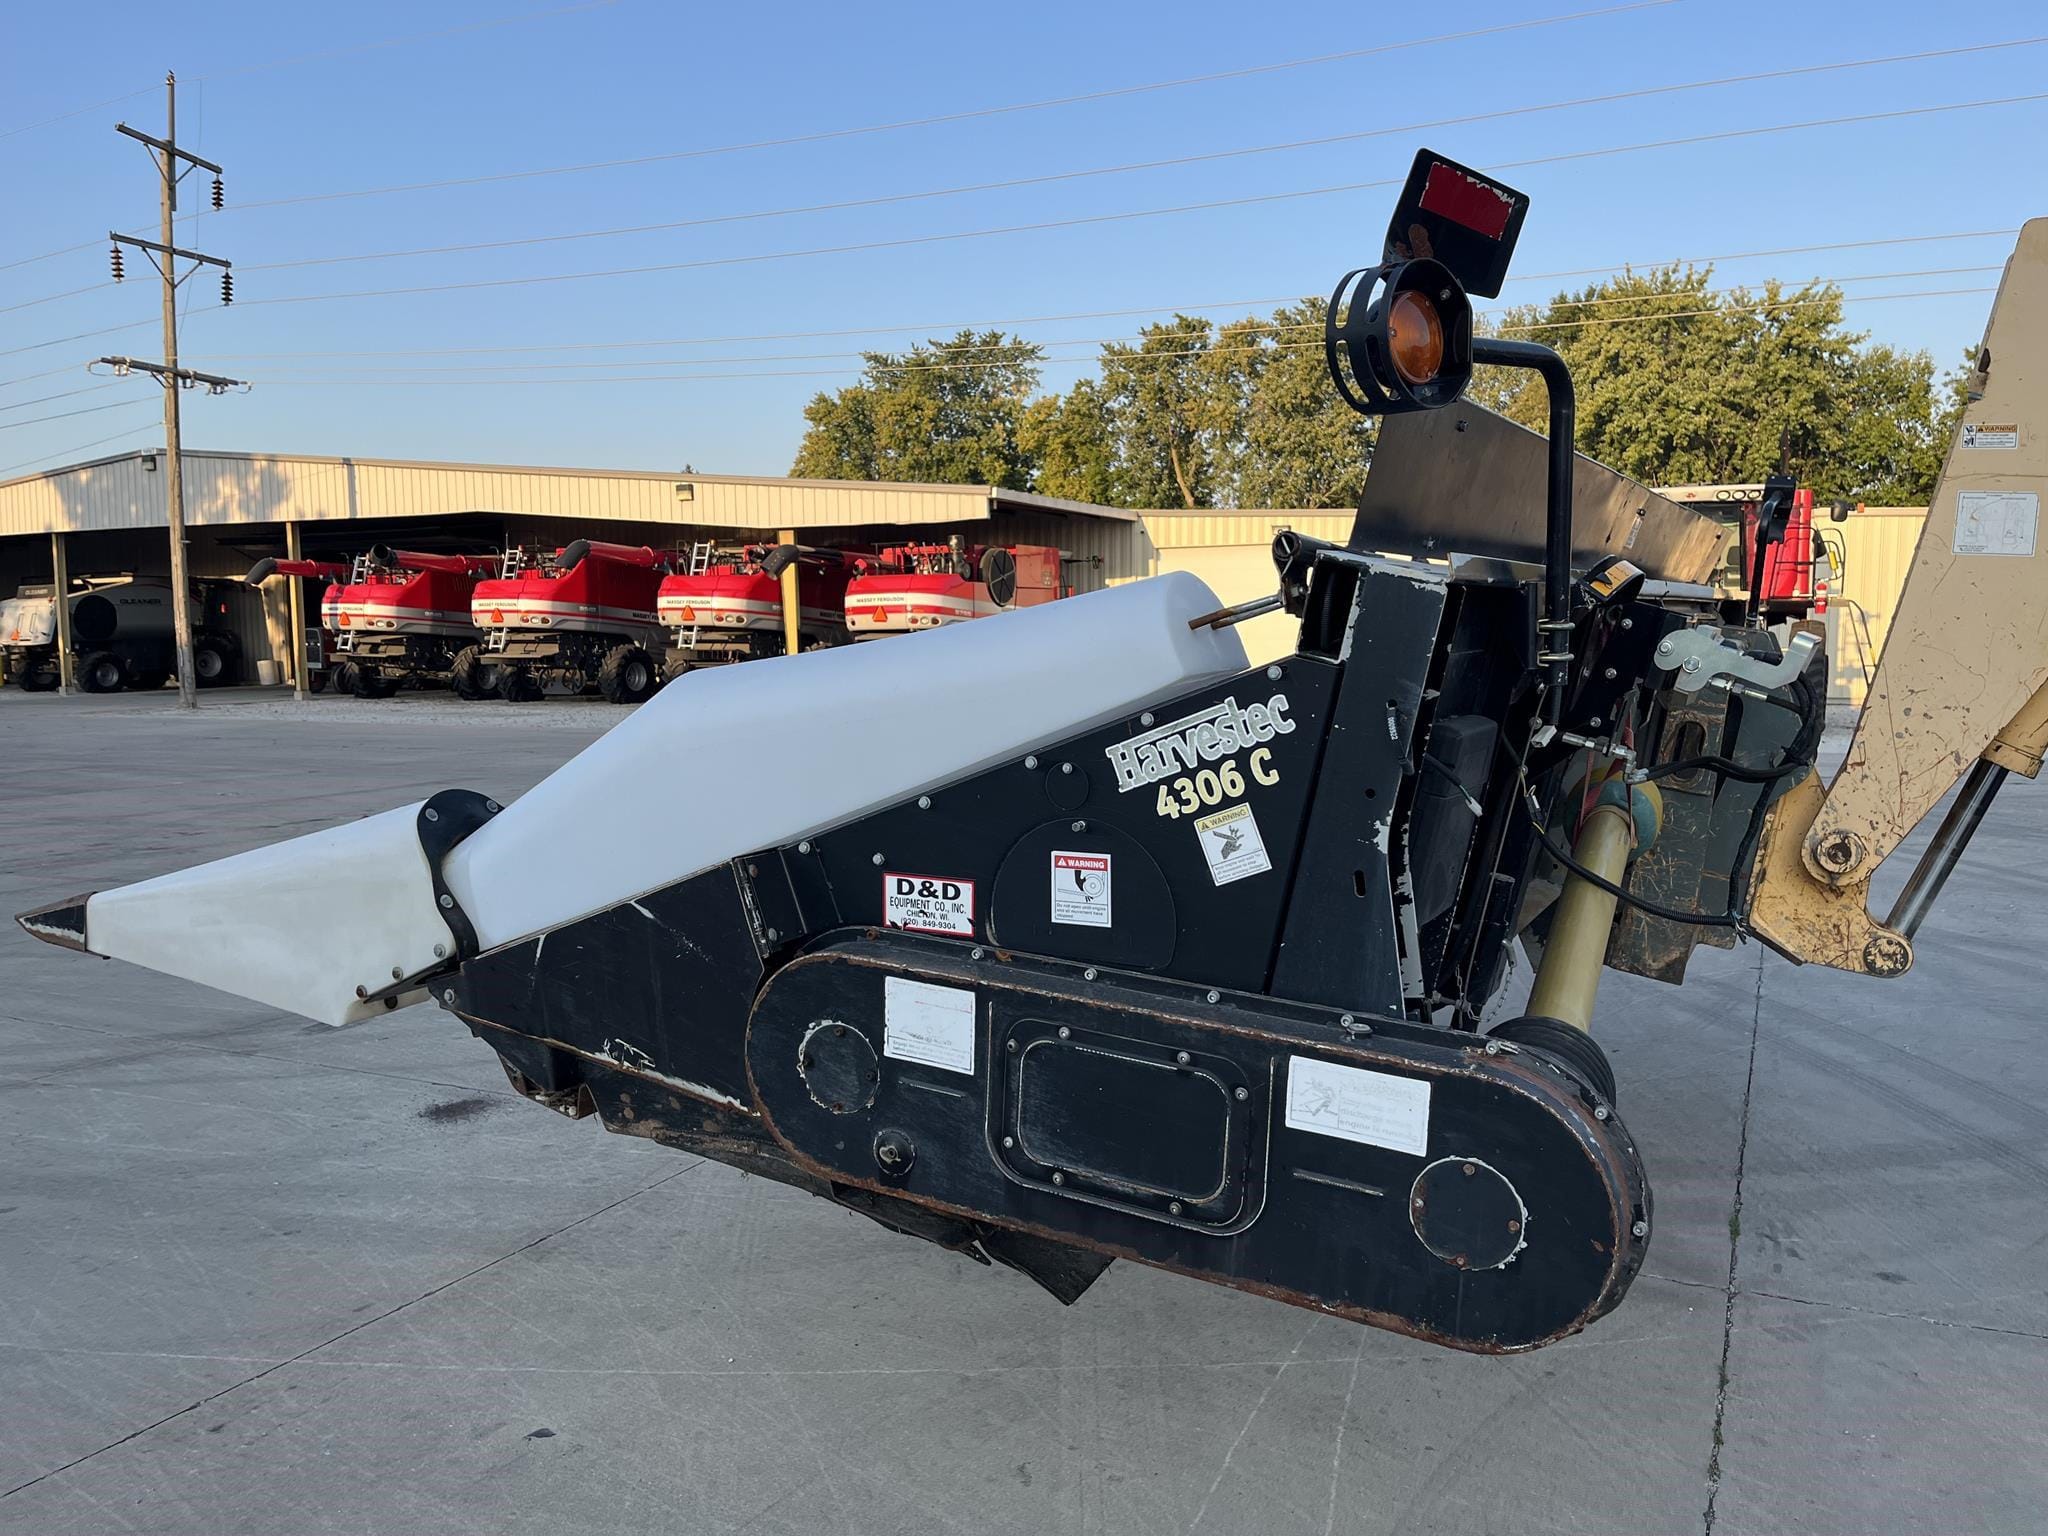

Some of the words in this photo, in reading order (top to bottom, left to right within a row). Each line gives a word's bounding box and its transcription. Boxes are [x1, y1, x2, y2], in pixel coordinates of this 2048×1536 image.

[1105, 694, 1296, 793] Harvestec
[1156, 760, 1245, 819] 4306
[1250, 747, 1280, 786] C
[1210, 809, 1247, 826] WARNING
[1068, 859, 1104, 868] WARNING
[897, 878, 961, 901] D&D
[889, 896, 930, 910] EQUIPMENT
[951, 903, 967, 914] INC.
[922, 919, 956, 930] 849-9304
